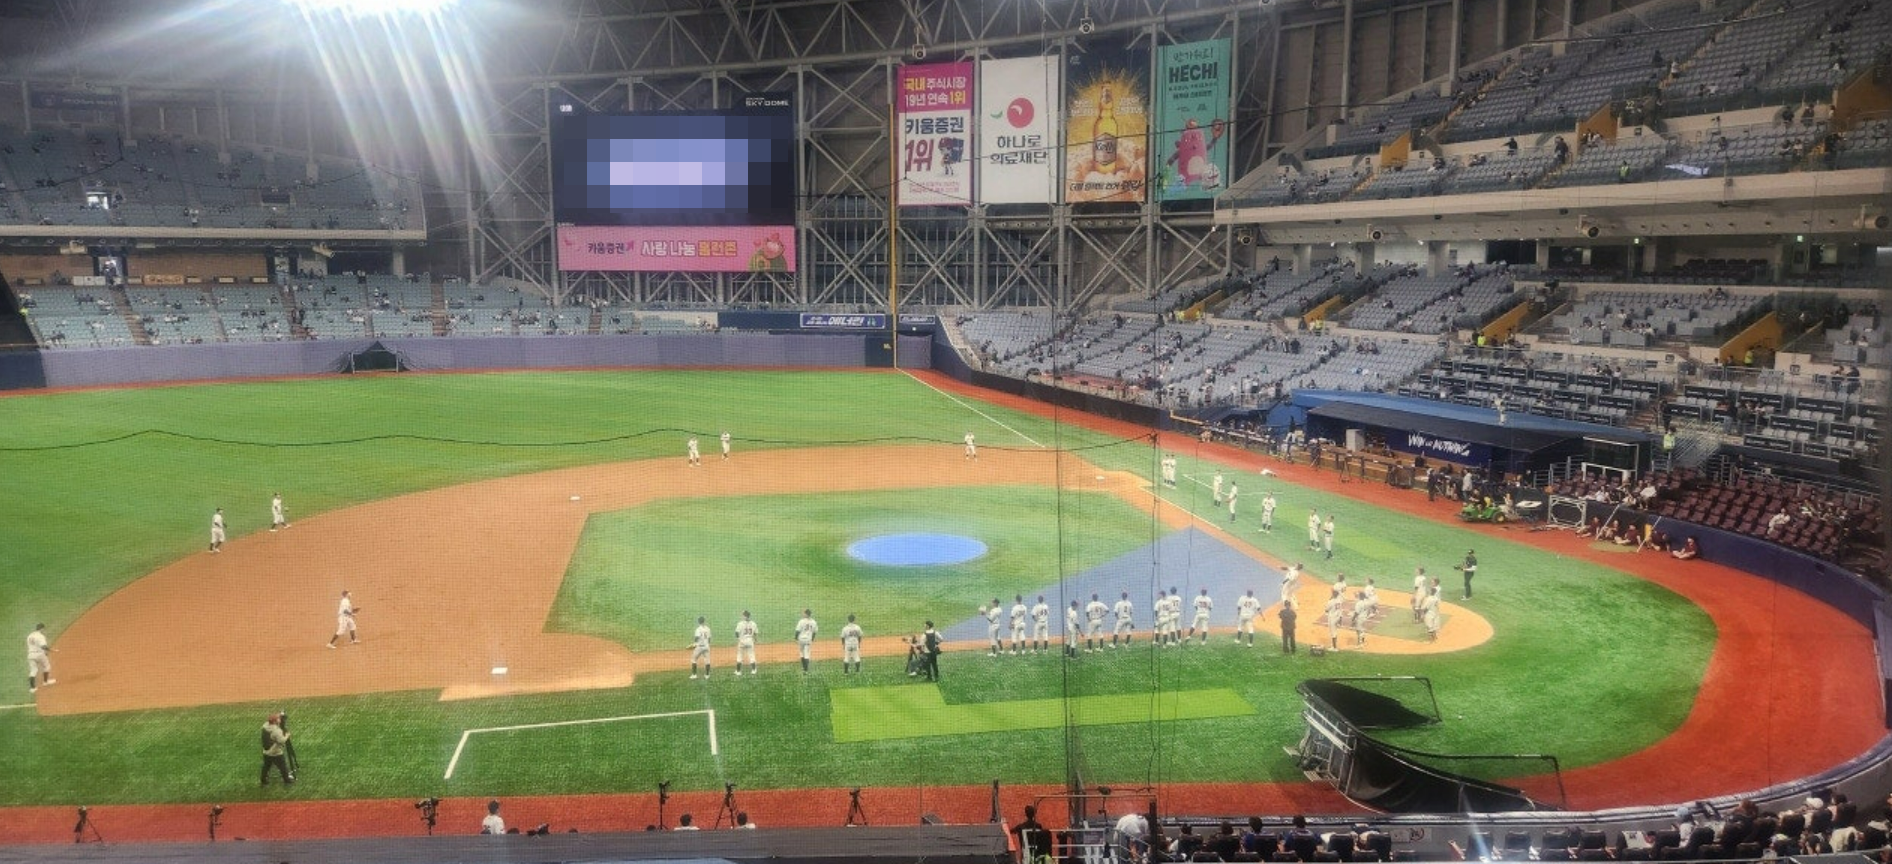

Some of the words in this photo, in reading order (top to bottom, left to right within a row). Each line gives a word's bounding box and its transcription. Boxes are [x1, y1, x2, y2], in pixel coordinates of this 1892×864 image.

[1169, 62, 1217, 83] HECHI
[904, 77, 926, 91] 국내
[927, 77, 966, 90] 주식시장
[905, 94, 926, 107] 19년
[927, 92, 948, 105] 연속
[950, 90, 966, 105] 1위
[905, 117, 964, 134] 키움증권
[997, 134, 1041, 148] 하나로
[905, 139, 934, 171] 1위
[990, 150, 1047, 164] 의료재단
[588, 242, 625, 254] 키움증권
[641, 240, 668, 257] 사랑
[670, 240, 696, 257] 나눔
